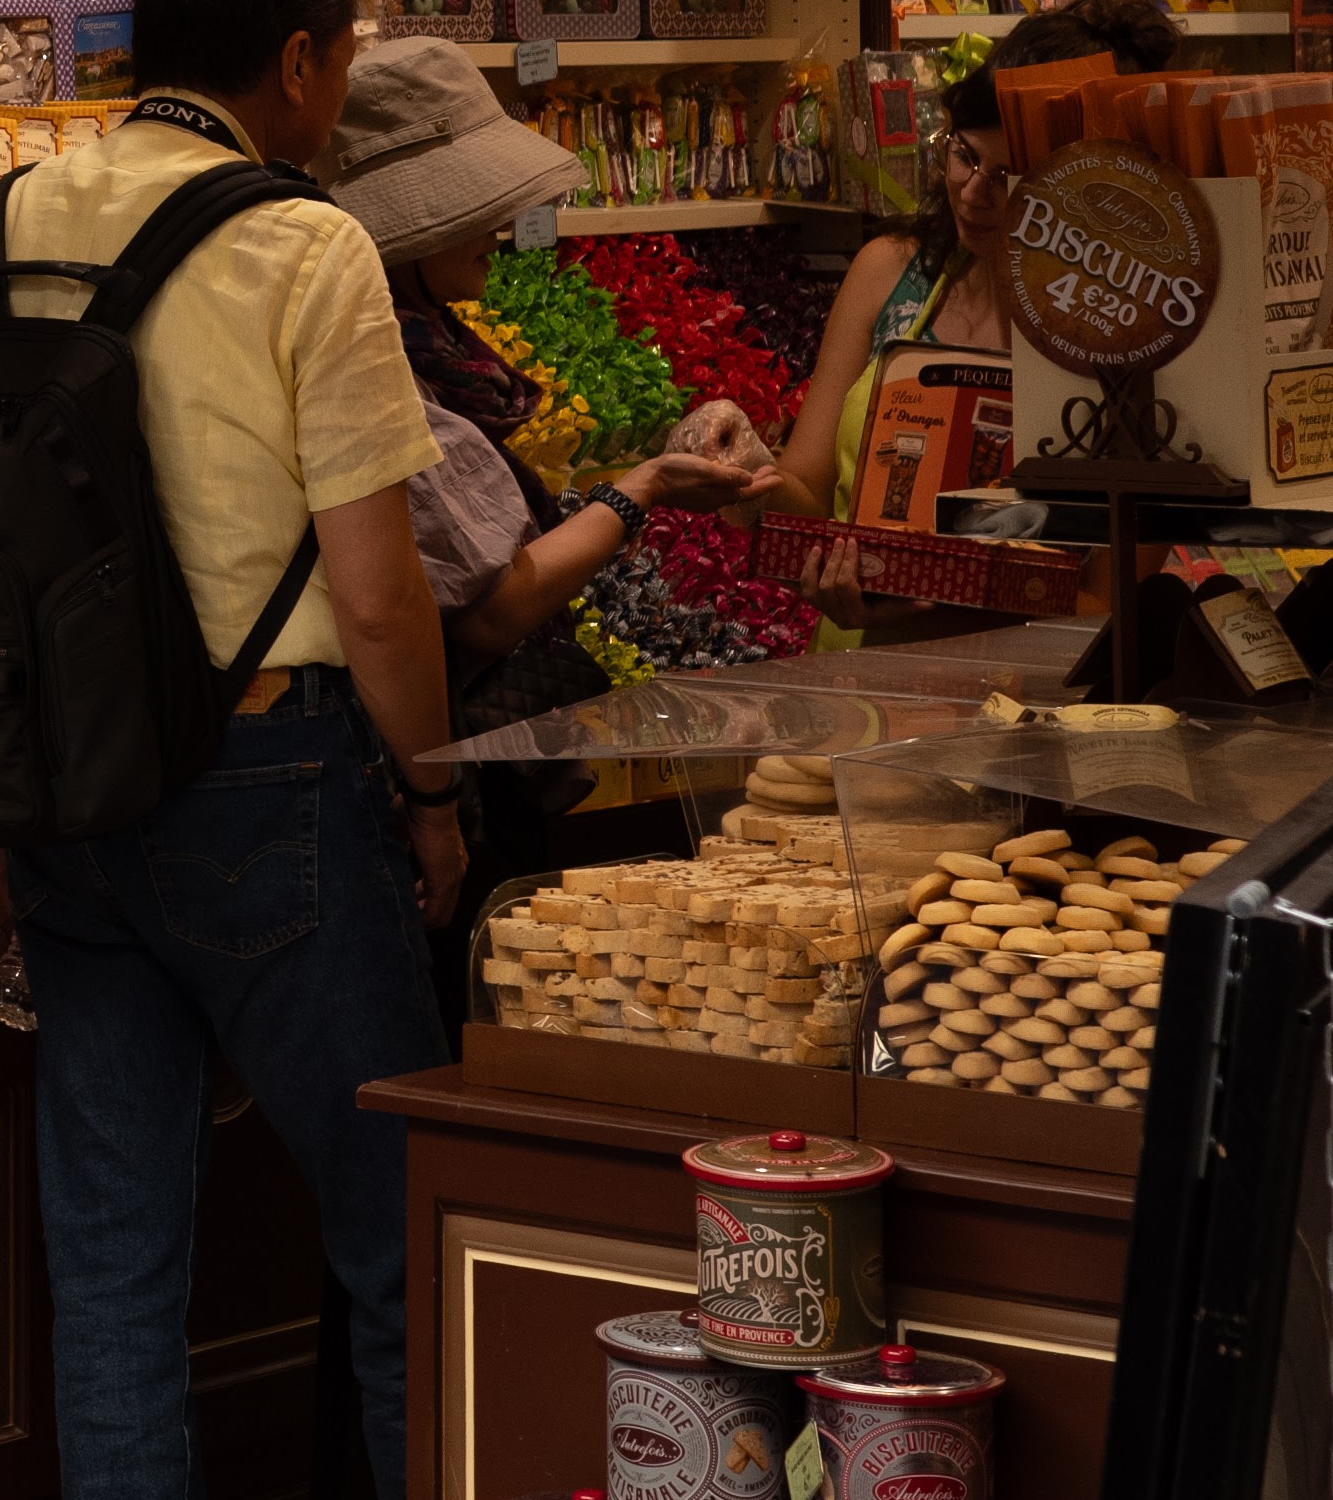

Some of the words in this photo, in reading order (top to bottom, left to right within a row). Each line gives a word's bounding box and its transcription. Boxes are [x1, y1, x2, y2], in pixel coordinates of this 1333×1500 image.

[141, 102, 216, 130] SONY
[1043, 157, 1101, 191] NAVETTES
[1116, 156, 1160, 185] SABLÉS
[1168, 192, 1200, 266] CROQUANTS
[1008, 249, 1022, 280] PUR
[1009, 195, 1204, 327] BISCUITS
[1013, 281, 1042, 329] BEURRE
[1074, 307, 1115, 337] /100g
[1051, 334, 1086, 361] OEUFS
[1089, 352, 1125, 365] FRAIS
[1128, 331, 1175, 363] ENTIERS
[891, 390, 924, 404] Fleur
[882, 407, 945, 430] d'Oranger
[1241, 629, 1272, 646] PALET
[701, 1196, 744, 1241] ARTISANALE
[712, 1323, 725, 1334] FINE
[727, 1326, 737, 1337] EN
[739, 1328, 786, 1343] PROVENCE
[607, 1384, 694, 1434] BISCUITERIE
[718, 1411, 776, 1436] CROQUANTS
[862, 1430, 977, 1476] BISCUITERIE
